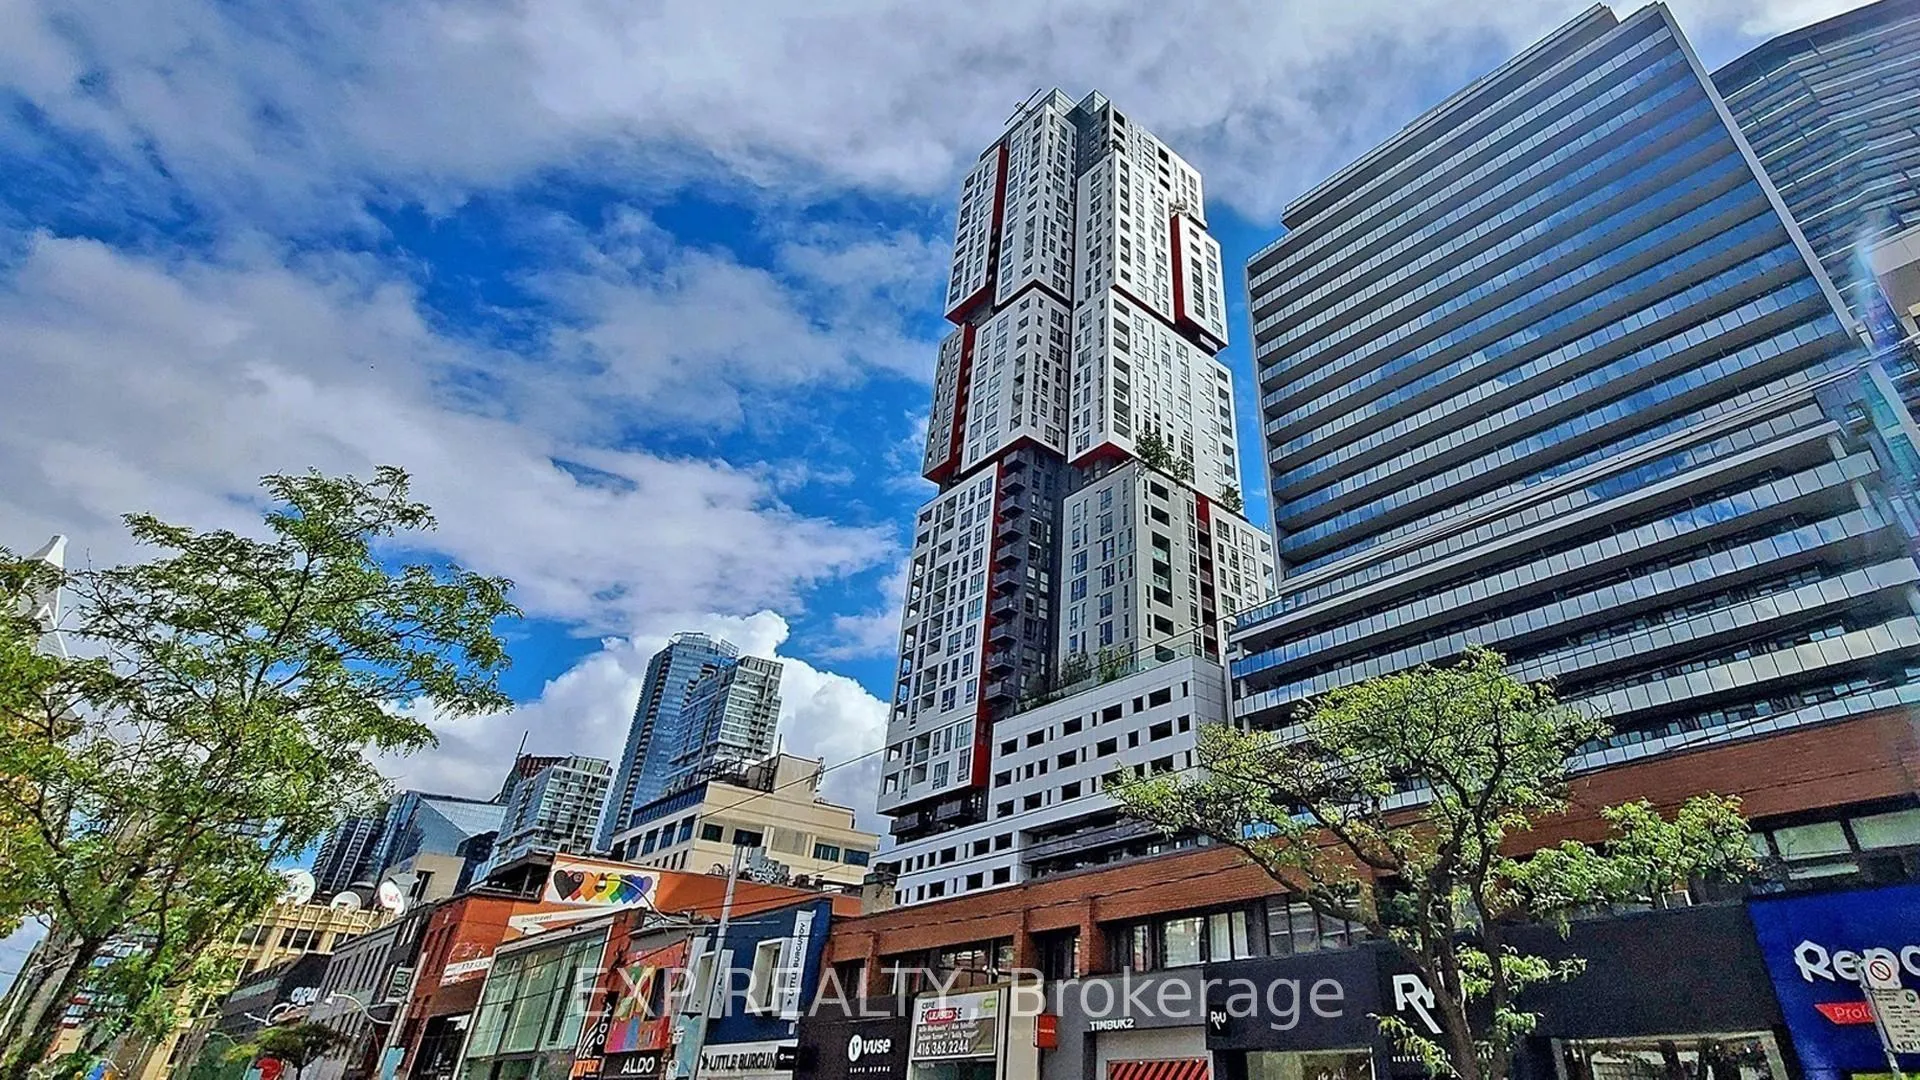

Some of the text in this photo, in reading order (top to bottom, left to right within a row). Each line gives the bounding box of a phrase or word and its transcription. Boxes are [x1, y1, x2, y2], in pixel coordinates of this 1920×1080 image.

[927, 1009, 954, 1021] LEASED
[596, 1002, 613, 1045] ALDO
[1089, 1018, 1135, 1031] TIMBUK2
[917, 1039, 969, 1055] 416 362 2244
[620, 1056, 655, 1074] ALDO
